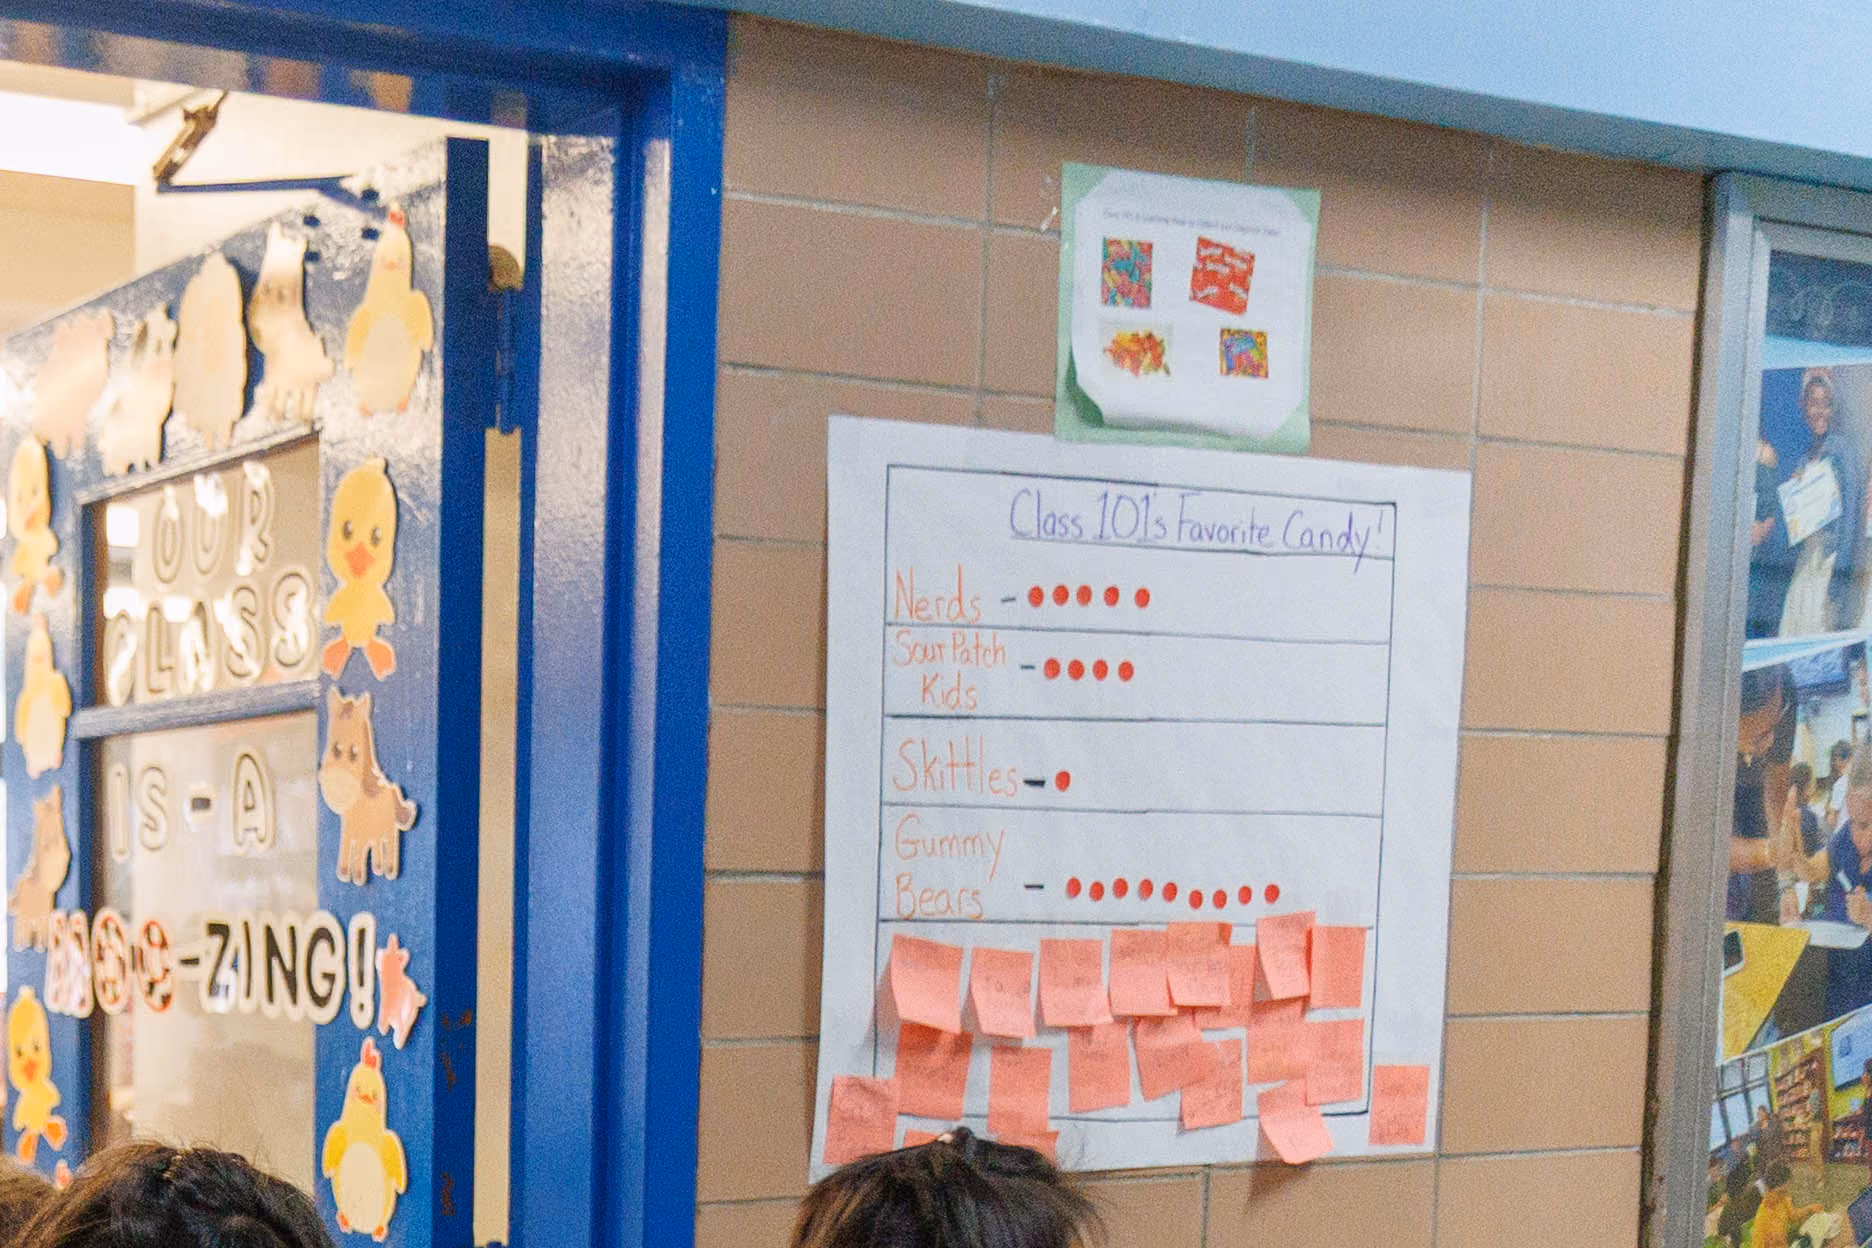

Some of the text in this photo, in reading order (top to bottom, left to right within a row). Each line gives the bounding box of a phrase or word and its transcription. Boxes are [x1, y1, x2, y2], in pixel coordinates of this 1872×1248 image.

[1010, 488, 1083, 540] Class
[1177, 492, 1272, 546] Favorite
[1283, 508, 1384, 574] Candy!
[894, 563, 982, 624] Nerds
[893, 628, 1007, 668] Sour Patch
[921, 670, 978, 712] Kids
[892, 735, 1018, 797] Skittles
[895, 812, 1006, 884] Gummy
[895, 872, 985, 920] Bears
